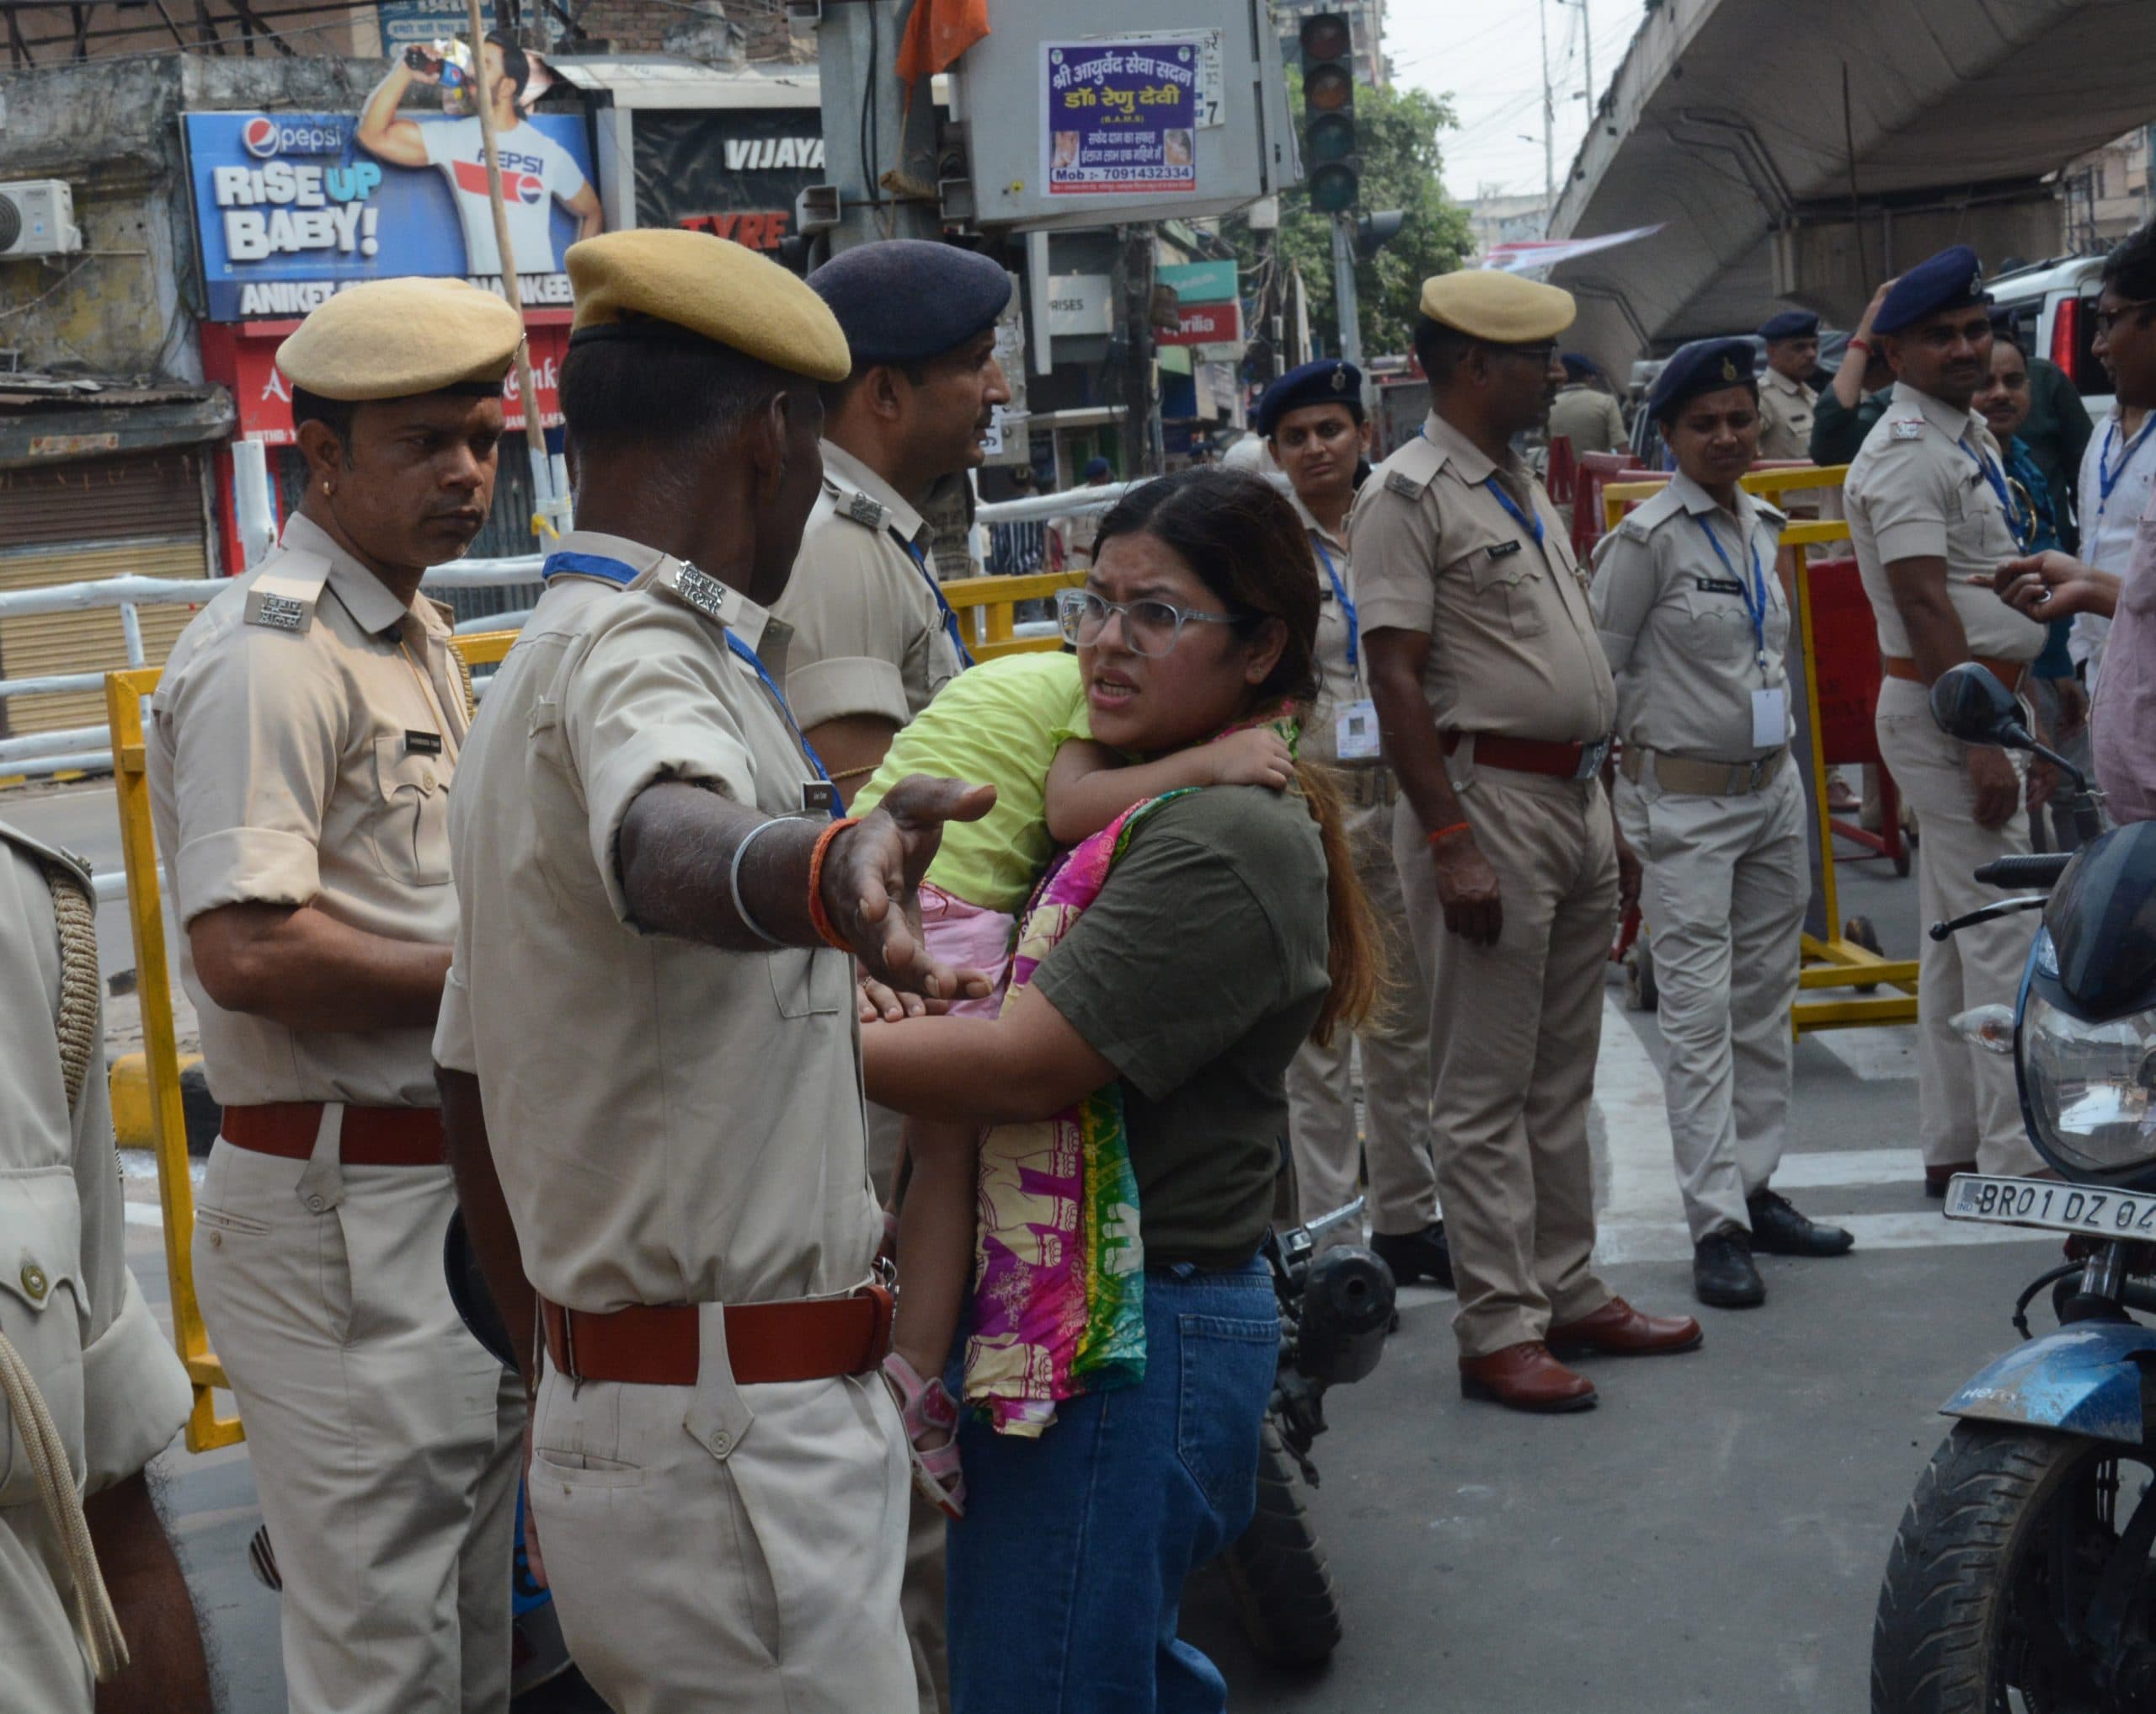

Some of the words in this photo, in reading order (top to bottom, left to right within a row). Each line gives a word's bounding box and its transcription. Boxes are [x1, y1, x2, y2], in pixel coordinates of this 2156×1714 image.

[1054, 64, 1071, 88] श्री
[1074, 51, 1123, 85] आयुर्वेद
[1125, 51, 1154, 75] सेवा
[1156, 61, 1193, 87] सदन
[1101, 86, 1135, 114] रेणु
[1139, 84, 1181, 104] देवी
[280, 125, 342, 152] pepsi
[326, 162, 382, 201] UP
[1056, 169, 1084, 179] Mob
[1104, 168, 1189, 179] 7091432334
[225, 202, 378, 260] BABY!
[1049, 299, 1084, 311] RISES
[1163, 314, 1215, 337] rilia
[1981, 1183, 2053, 1219] BR01
[2063, 1192, 2108, 1226] DZ
